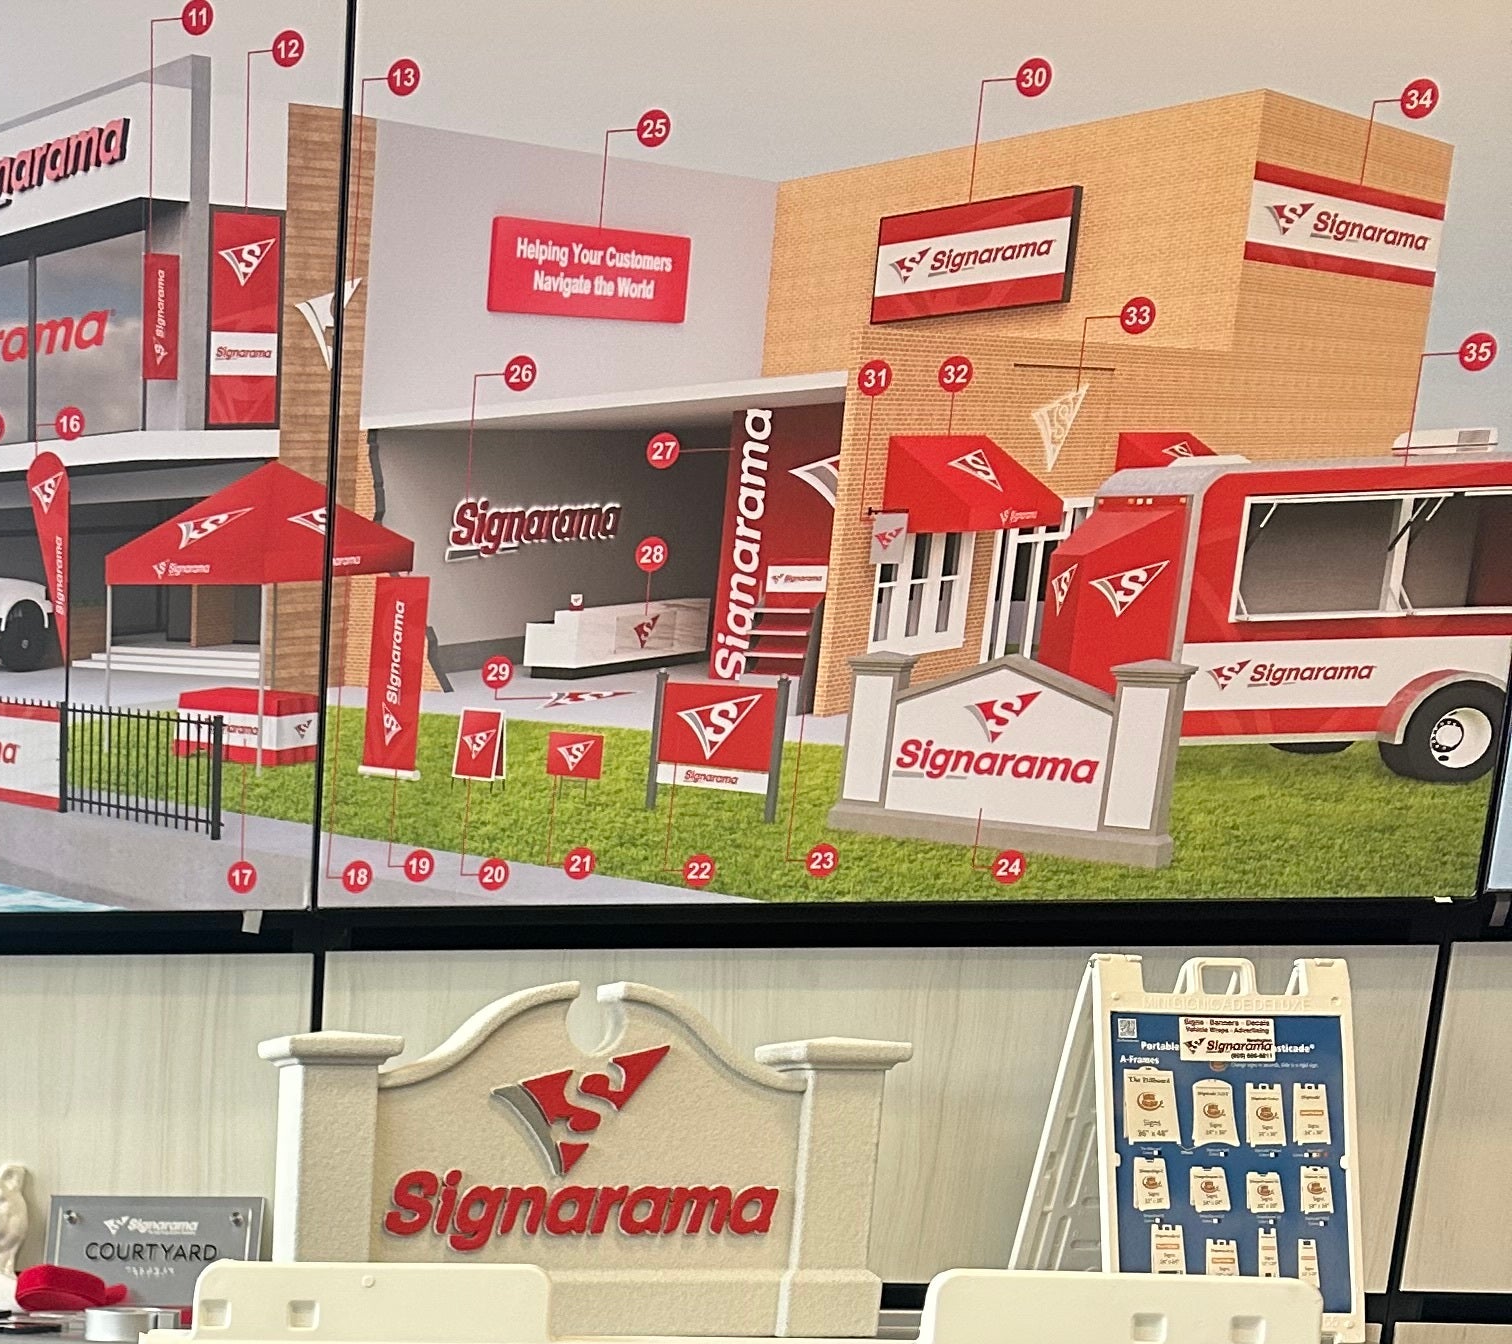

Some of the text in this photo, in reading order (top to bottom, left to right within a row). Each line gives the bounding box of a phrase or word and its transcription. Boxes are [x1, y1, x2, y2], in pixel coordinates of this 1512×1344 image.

[188, 7, 207, 27] 11
[277, 39, 300, 59] 12
[392, 67, 415, 87] 13
[1021, 67, 1047, 88] 30
[1407, 89, 1433, 110] 34
[642, 118, 667, 139] 25
[1312, 210, 1430, 251] Signarama
[516, 237, 673, 272] Helping Your Customers
[929, 239, 1054, 273] Signarama
[533, 270, 655, 300] Navigate the World
[155, 269, 166, 335] Signarama
[1126, 305, 1151, 326] 33
[216, 346, 272, 360] Signarama
[1465, 342, 1491, 363] 35
[509, 364, 533, 383] 26
[863, 368, 887, 388] 31
[943, 364, 968, 384] 32
[59, 415, 81, 433] 16
[651, 441, 676, 461] 27
[450, 498, 622, 556] Signarama
[640, 545, 664, 564] 28
[389, 600, 405, 704] Signarama
[486, 663, 510, 681] 29
[1249, 662, 1374, 687] Signarama
[895, 739, 1099, 784] Signarama
[684, 769, 738, 785] Signarama
[408, 857, 430, 875] 19
[569, 855, 591, 873] 21
[810, 851, 834, 870] 23
[997, 858, 1021, 877] 24
[231, 869, 253, 886] 17
[347, 868, 368, 886] 18
[482, 865, 506, 883] 20
[687, 862, 712, 880] 22
[1206, 1040, 1272, 1053] Signarama
[385, 1169, 779, 1253] Signarama
[85, 1241, 217, 1261] COURTYARD
